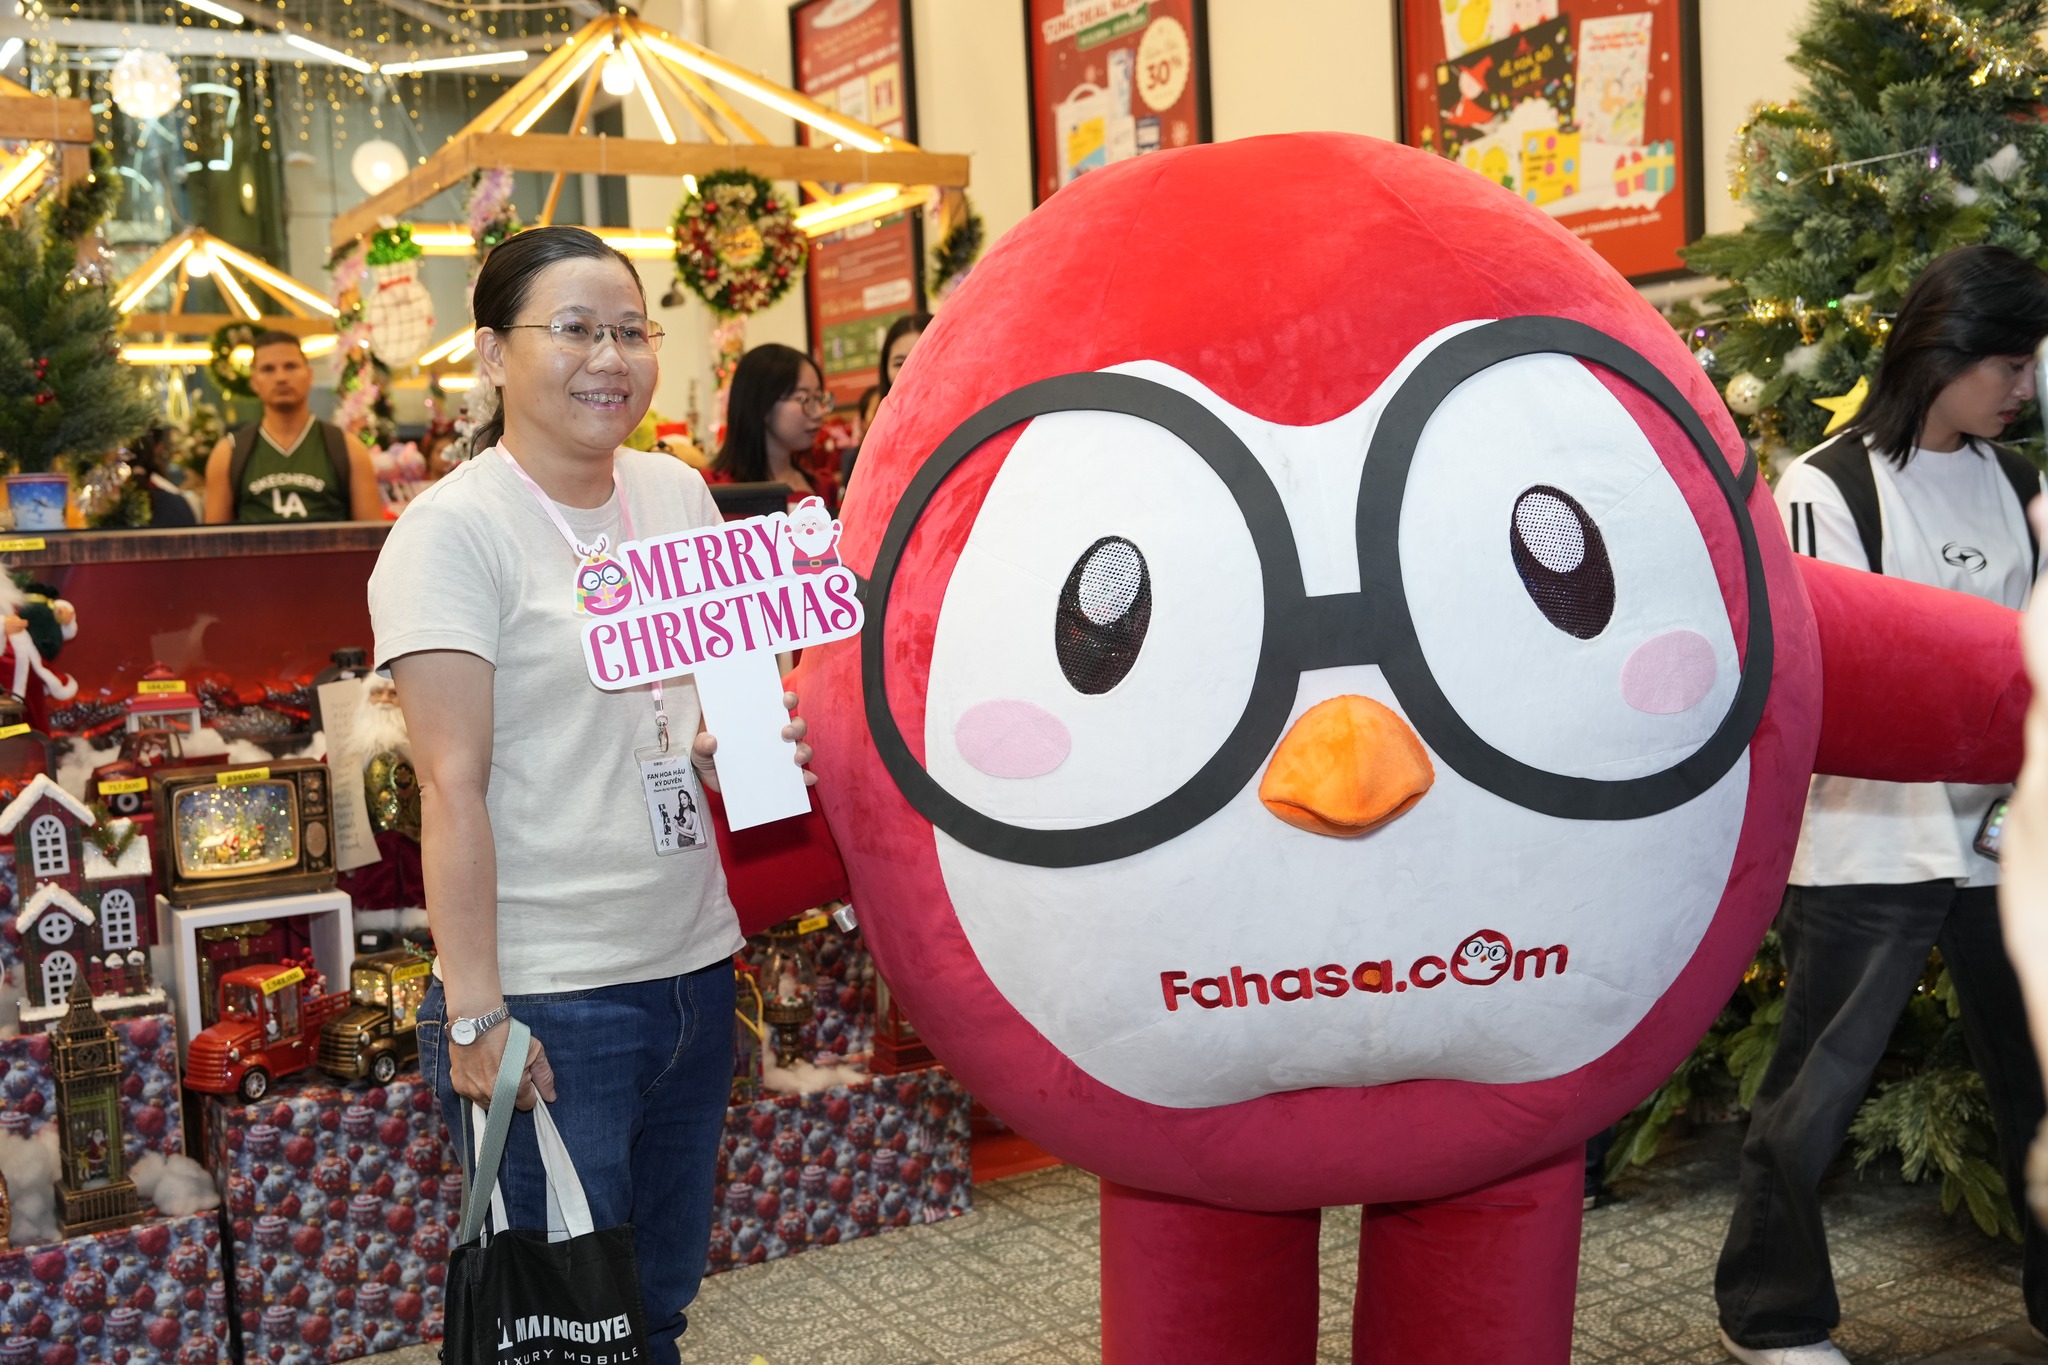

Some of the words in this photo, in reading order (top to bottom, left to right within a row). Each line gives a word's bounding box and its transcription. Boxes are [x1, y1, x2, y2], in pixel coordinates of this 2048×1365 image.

[272, 488, 308, 518] LA
[627, 520, 784, 606] MERRY
[589, 574, 857, 682] CHRISTMAS
[647, 772, 659, 780] FAN
[660, 770, 672, 778] HOA
[673, 767, 686, 777] HẬU
[664, 776, 683, 786] DUYÊN
[1160, 929, 1569, 1012] Fahasa.com
[564, 1346, 639, 1365] MOBILE
